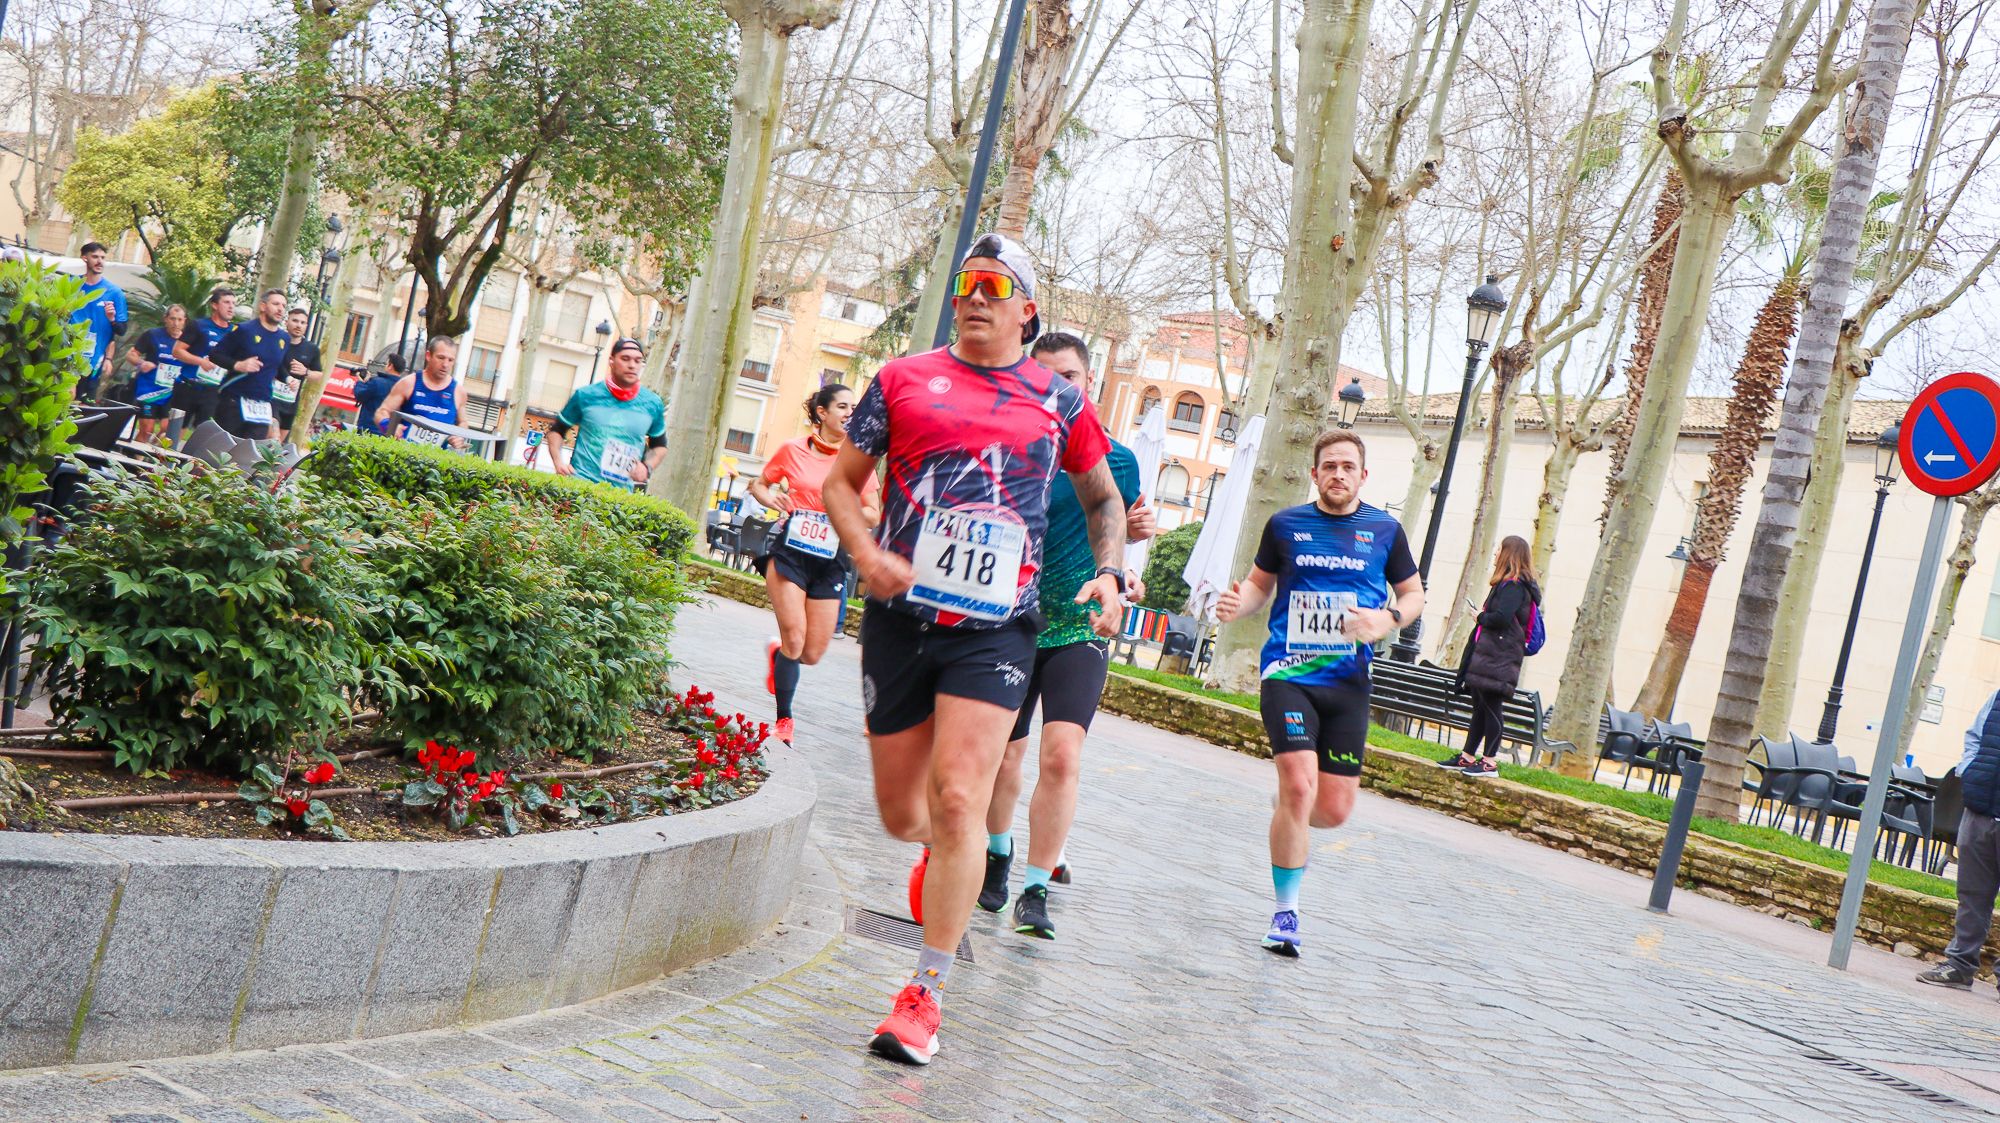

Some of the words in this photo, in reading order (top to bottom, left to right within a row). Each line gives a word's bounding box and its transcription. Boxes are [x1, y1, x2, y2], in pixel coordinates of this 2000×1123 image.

[414, 427, 440, 444] 1058
[800, 521, 829, 541] 604
[936, 543, 996, 586] 418
[1295, 553, 1367, 571] enerplus
[1298, 612, 1345, 635] 1444
